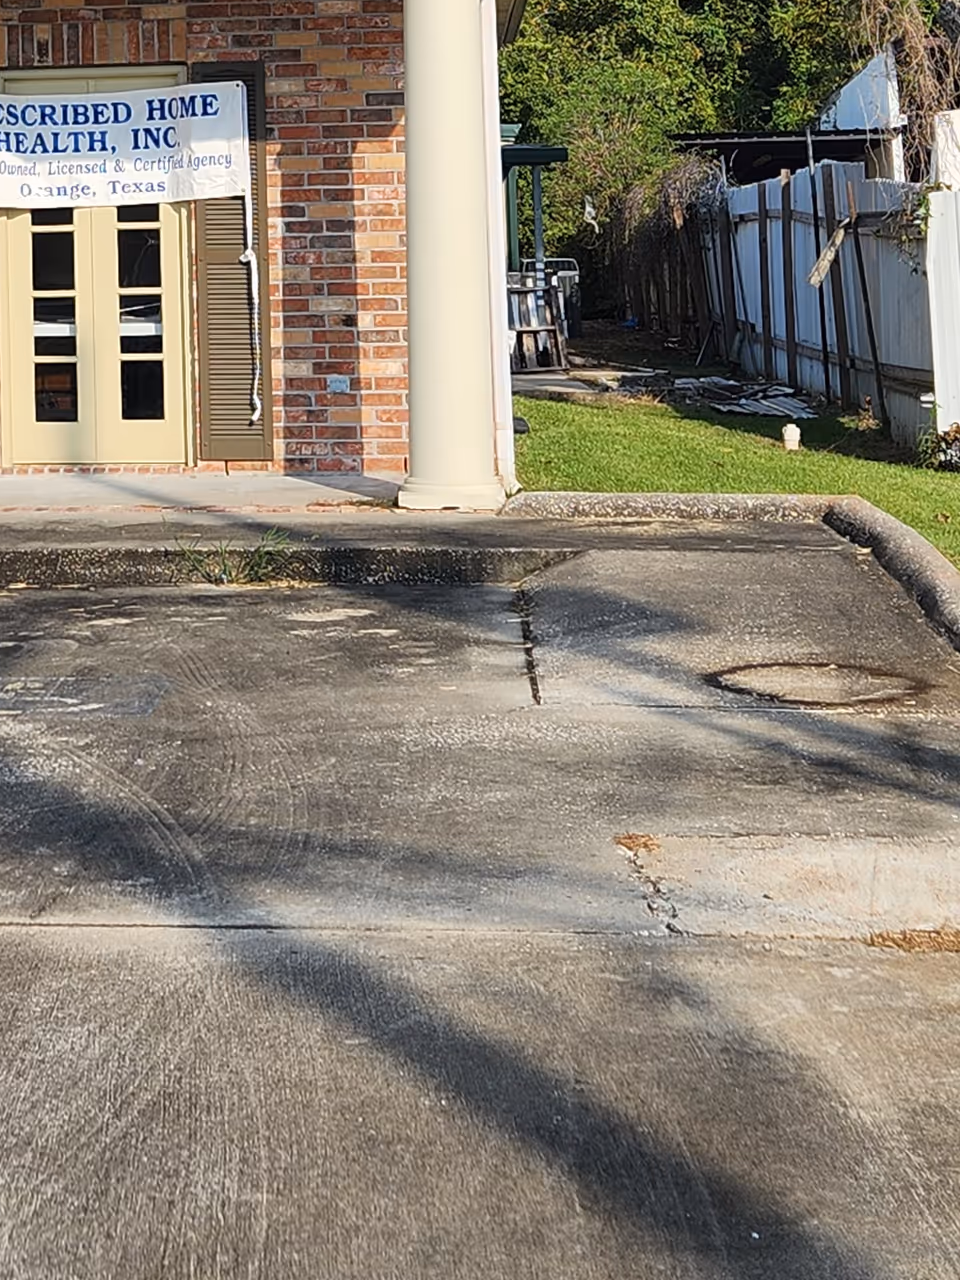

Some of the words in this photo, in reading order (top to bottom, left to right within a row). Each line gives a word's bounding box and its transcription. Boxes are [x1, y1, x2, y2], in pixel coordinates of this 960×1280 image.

[146, 94, 220, 121] HOME
[131, 126, 181, 150] INC.
[48, 159, 107, 175] Licensed
[114, 158, 126, 173] &
[134, 155, 184, 174] Certified
[187, 153, 232, 171] Agency
[107, 180, 166, 195] Texas
